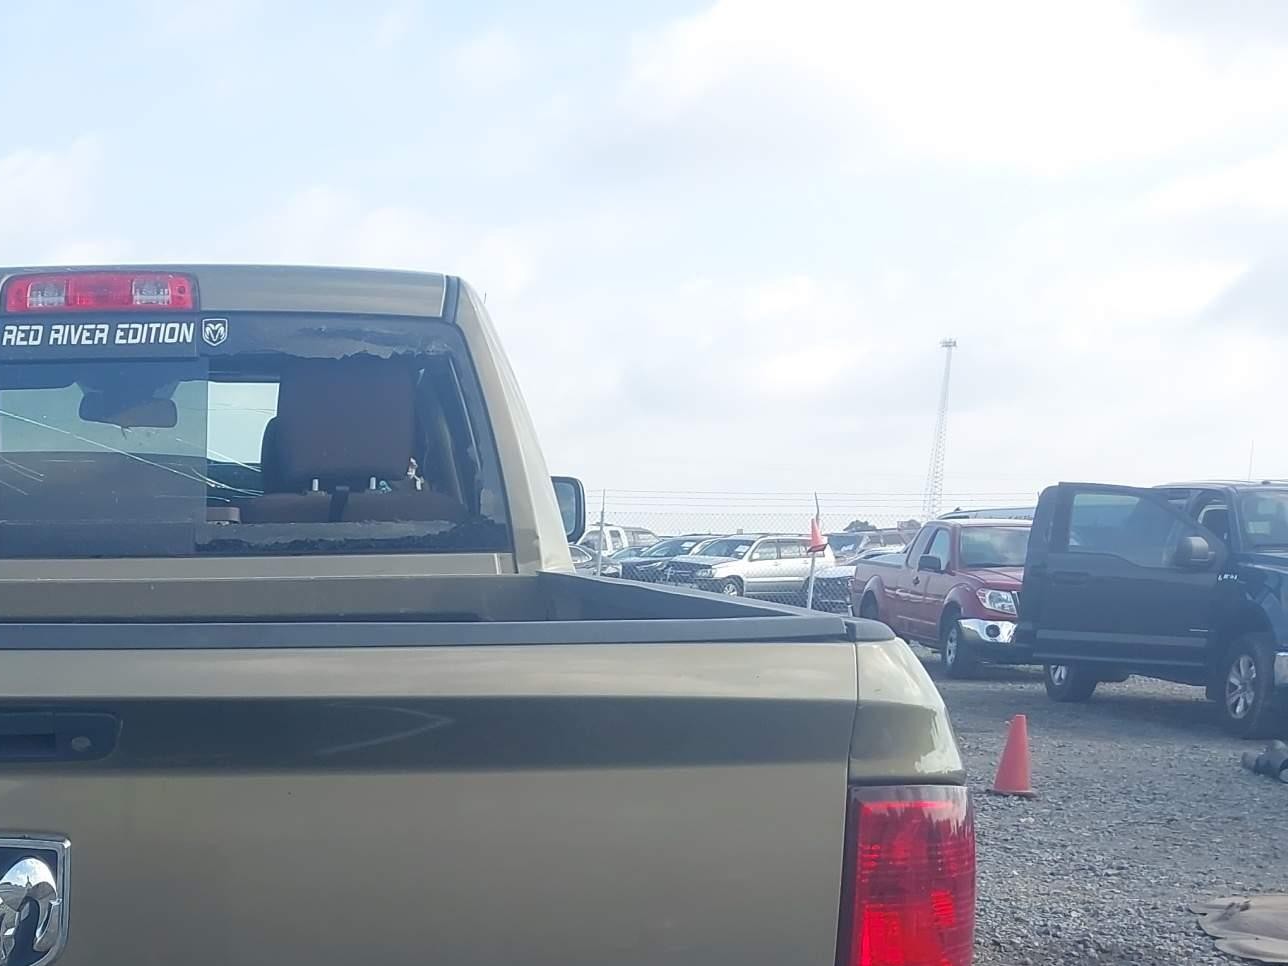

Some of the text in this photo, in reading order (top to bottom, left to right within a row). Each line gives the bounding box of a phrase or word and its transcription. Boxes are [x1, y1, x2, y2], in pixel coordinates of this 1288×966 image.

[2, 322, 194, 346] RED RIVER EDITION
